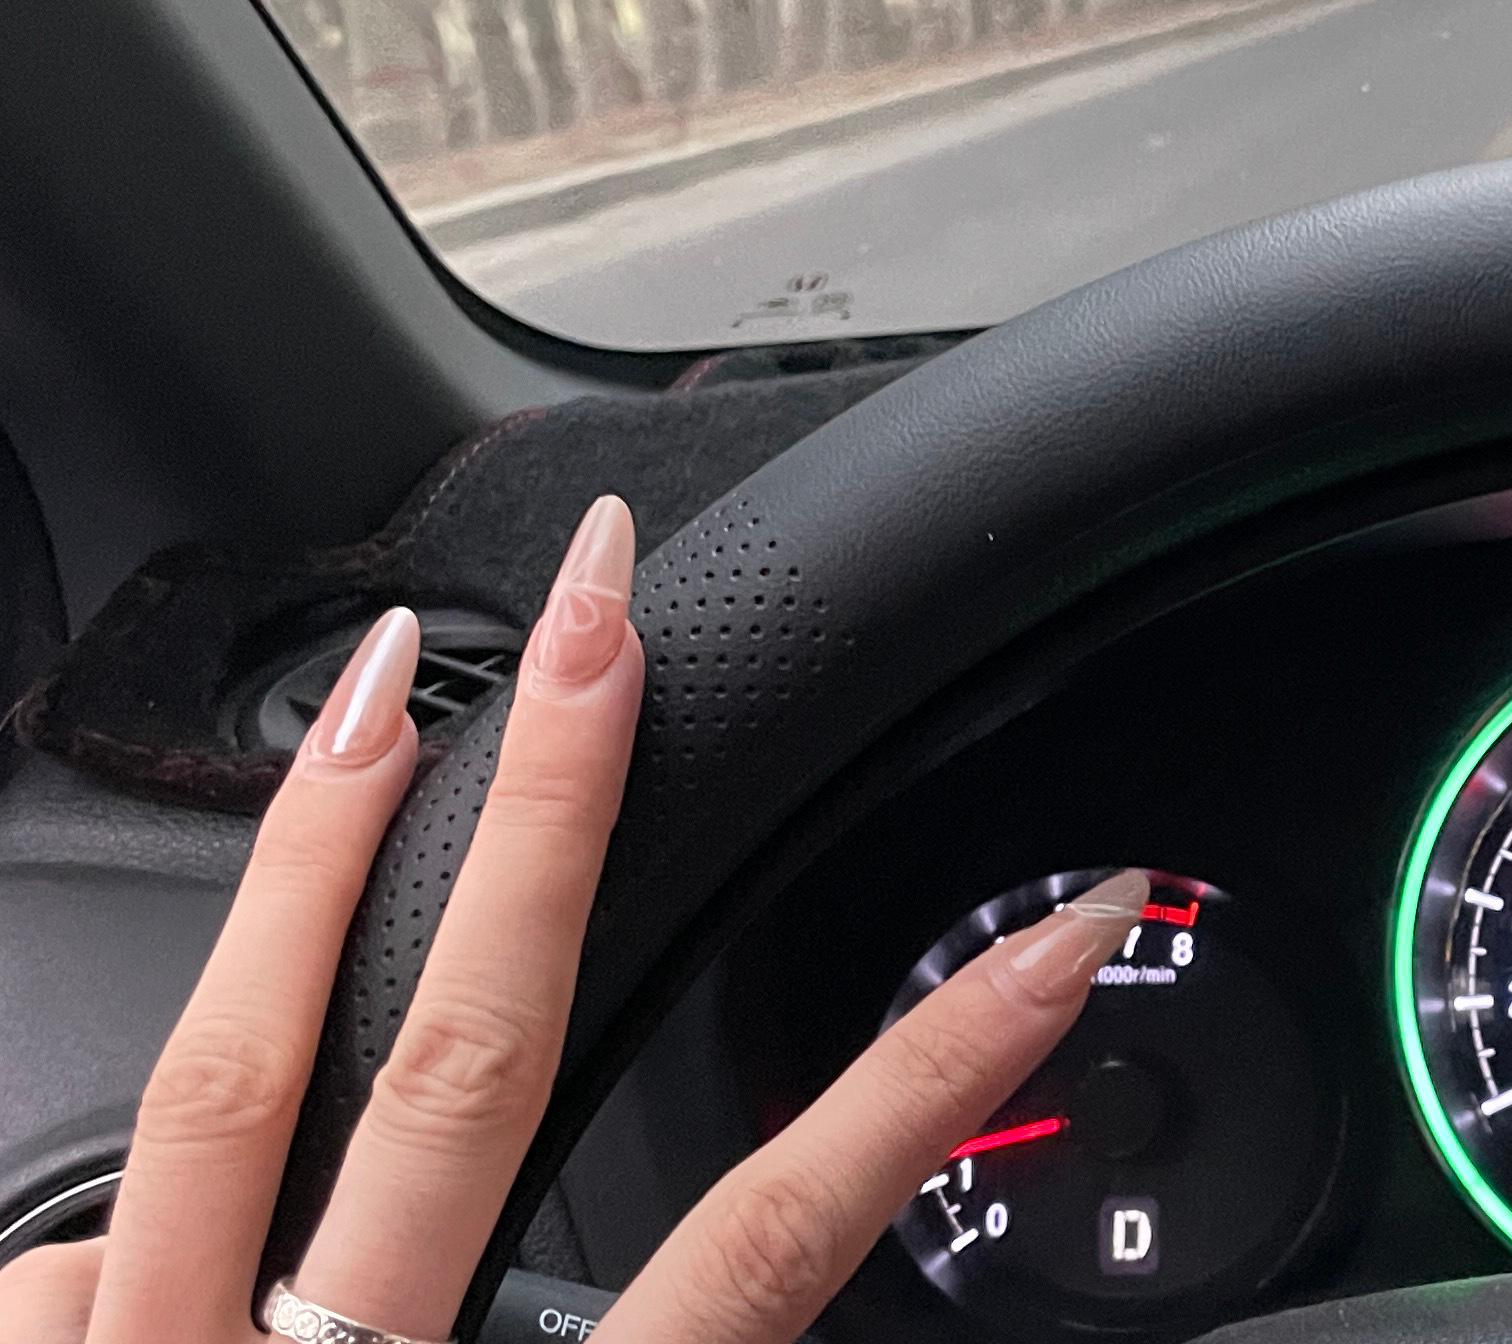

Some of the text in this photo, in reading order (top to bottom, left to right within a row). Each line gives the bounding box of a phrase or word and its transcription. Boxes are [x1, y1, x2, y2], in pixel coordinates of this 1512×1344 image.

[1170, 931, 1195, 967] 8
[958, 1157, 974, 1193] 1
[985, 1202, 1009, 1238] 0
[1112, 1209, 1153, 1261] D
[538, 1307, 598, 1342] OFF
